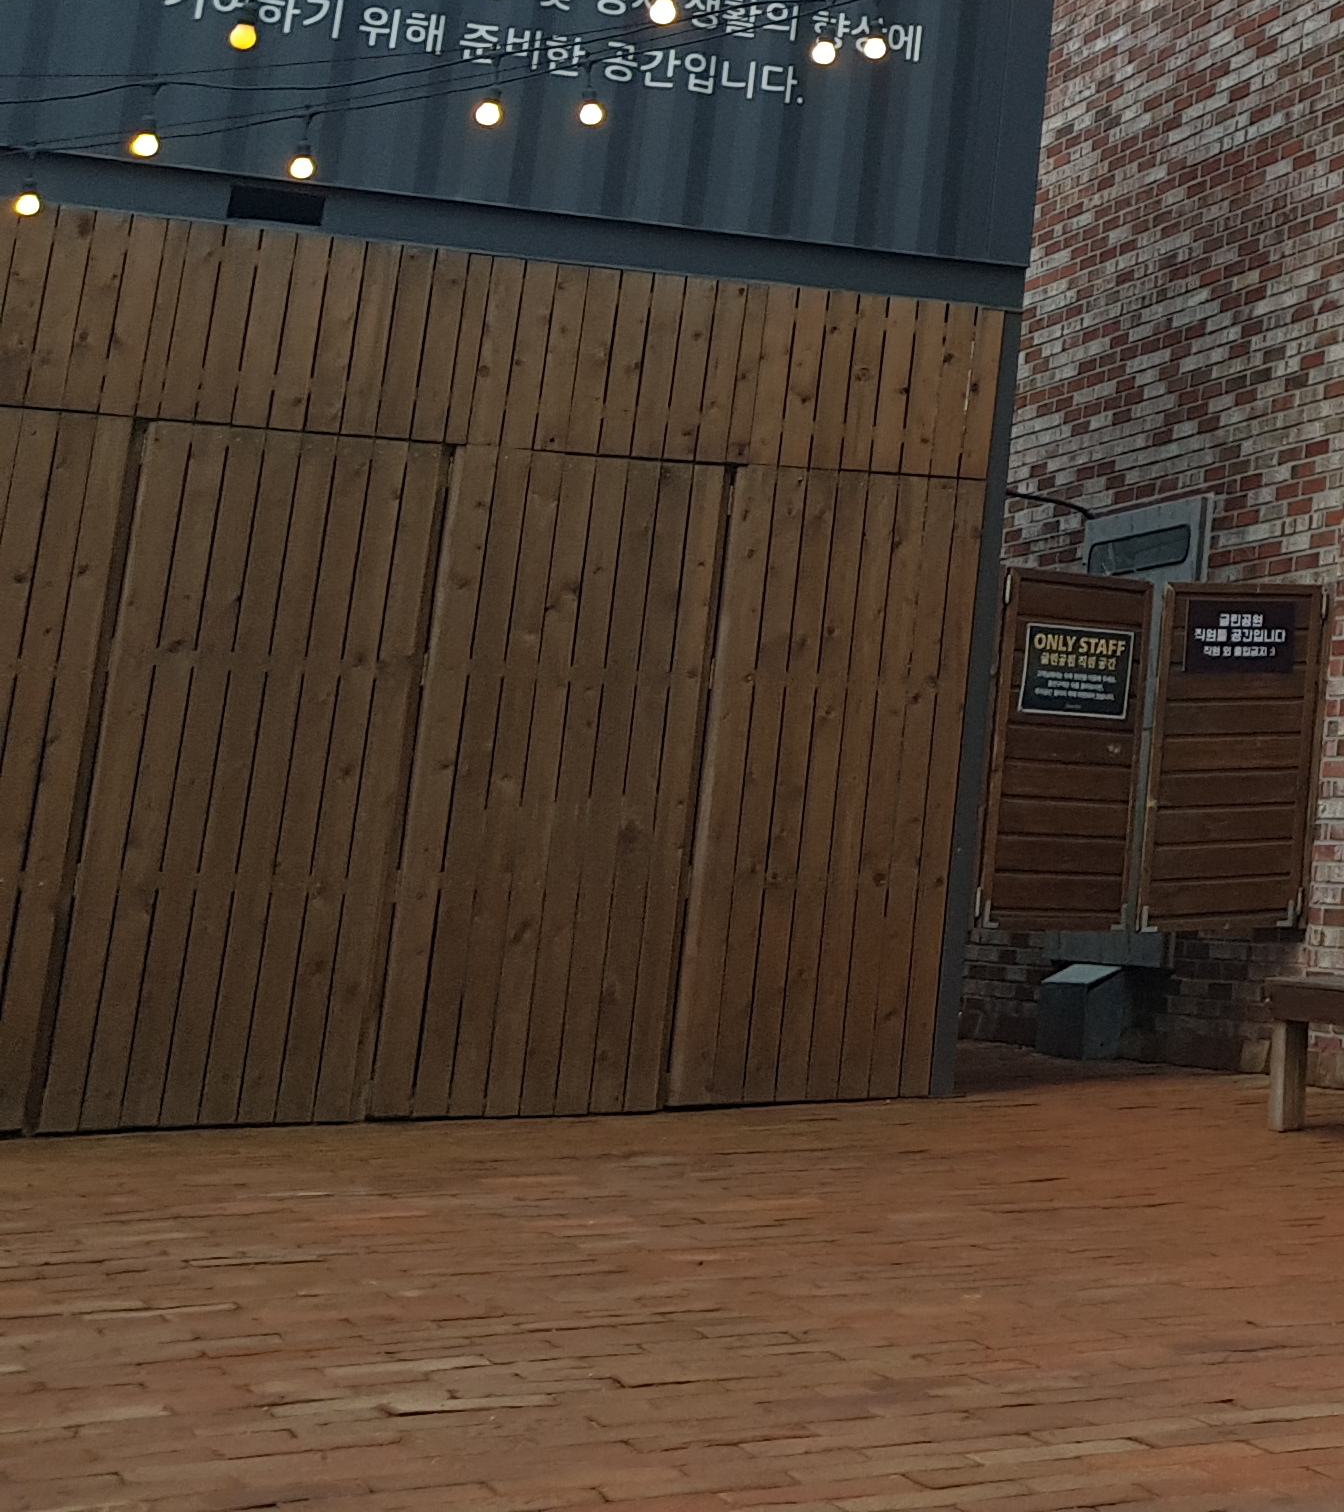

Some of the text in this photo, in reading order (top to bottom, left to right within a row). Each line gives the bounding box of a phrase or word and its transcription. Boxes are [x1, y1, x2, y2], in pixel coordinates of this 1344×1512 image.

[358, 5, 446, 57] 위해
[458, 21, 587, 78] 준비한
[600, 39, 805, 105] 공간입니다.
[1034, 632, 1127, 656] ONLY STAFF
[1230, 628, 1287, 643] 공간입니다
